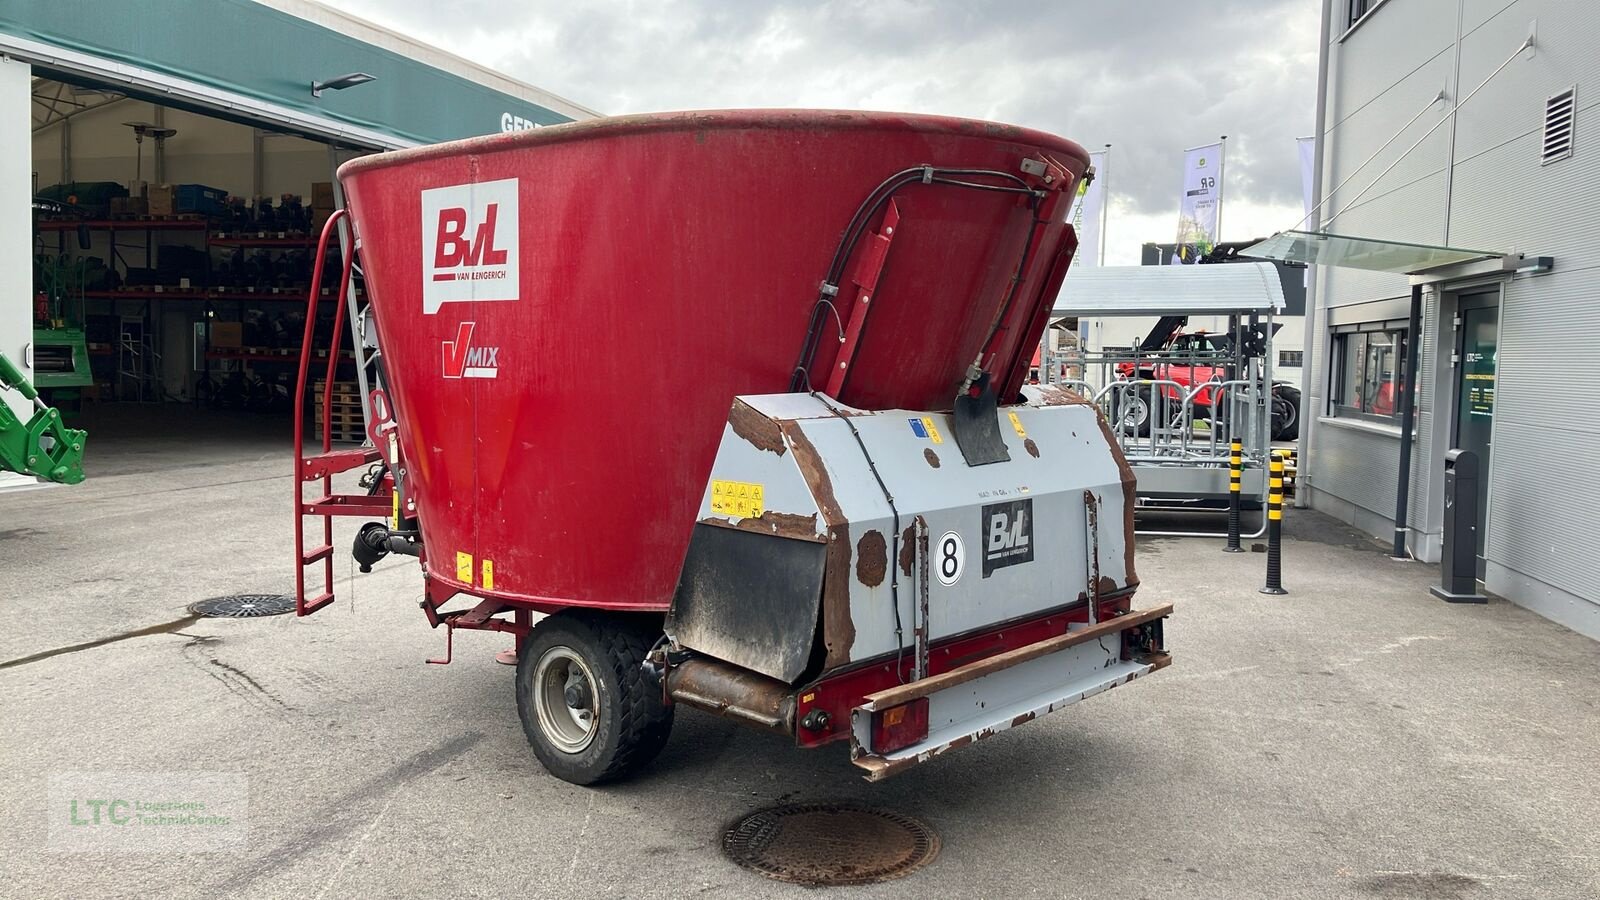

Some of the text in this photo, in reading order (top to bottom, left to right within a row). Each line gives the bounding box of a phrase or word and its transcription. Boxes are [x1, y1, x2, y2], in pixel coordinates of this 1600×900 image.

[457, 270, 506, 281] VAN LENGERICH
[942, 538, 958, 578] 8
